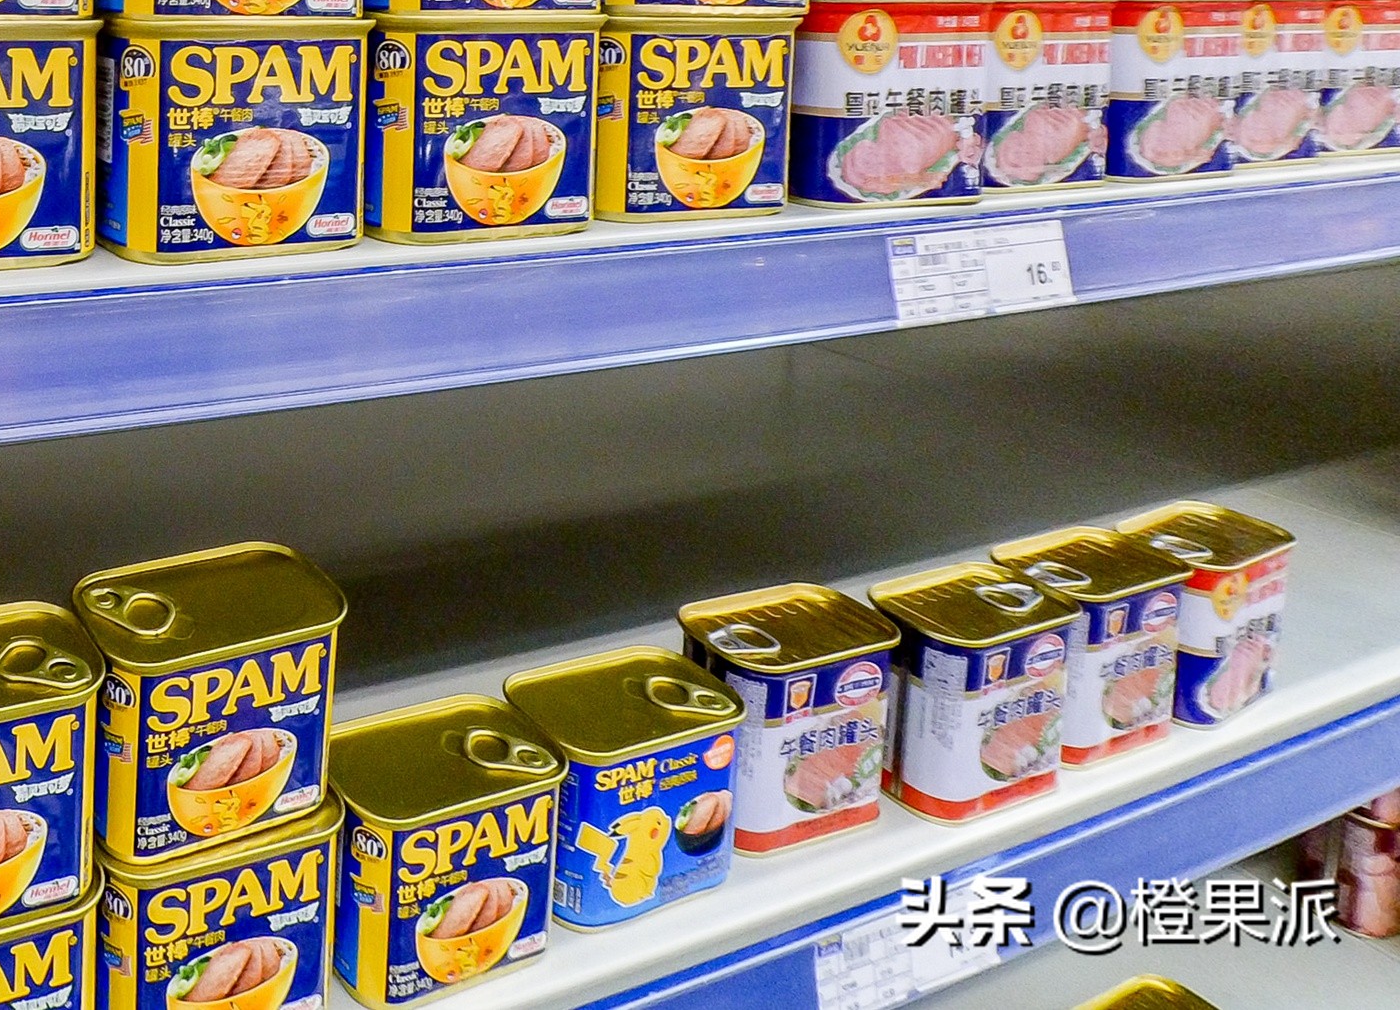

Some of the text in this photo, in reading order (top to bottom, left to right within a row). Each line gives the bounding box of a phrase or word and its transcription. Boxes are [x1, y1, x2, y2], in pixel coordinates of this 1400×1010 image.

[124, 56, 142, 77] 80
[378, 48, 401, 68] 80
[422, 39, 588, 96] SPAM
[637, 38, 787, 90] SPAM
[167, 45, 354, 107] SPAM
[422, 97, 465, 118] 世棒
[636, 91, 675, 109] 世棒
[167, 108, 214, 130] 世棒
[168, 133, 197, 148] 罐头
[414, 198, 447, 209] Classic
[160, 216, 195, 227] Classic
[314, 219, 350, 227] Hormel
[30, 231, 70, 241] Hormel
[147, 642, 326, 732] SPAM
[976, 690, 1062, 729] 午餐肉罐头
[146, 729, 191, 755] 世棒
[780, 719, 879, 758] 午餐肉罐头
[595, 758, 657, 790] SPAM
[619, 780, 655, 805] 世棒
[356, 831, 378, 853] 80
[397, 794, 551, 884] SPAM
[145, 849, 322, 944] SPAM
[144, 942, 189, 966] 世棒
